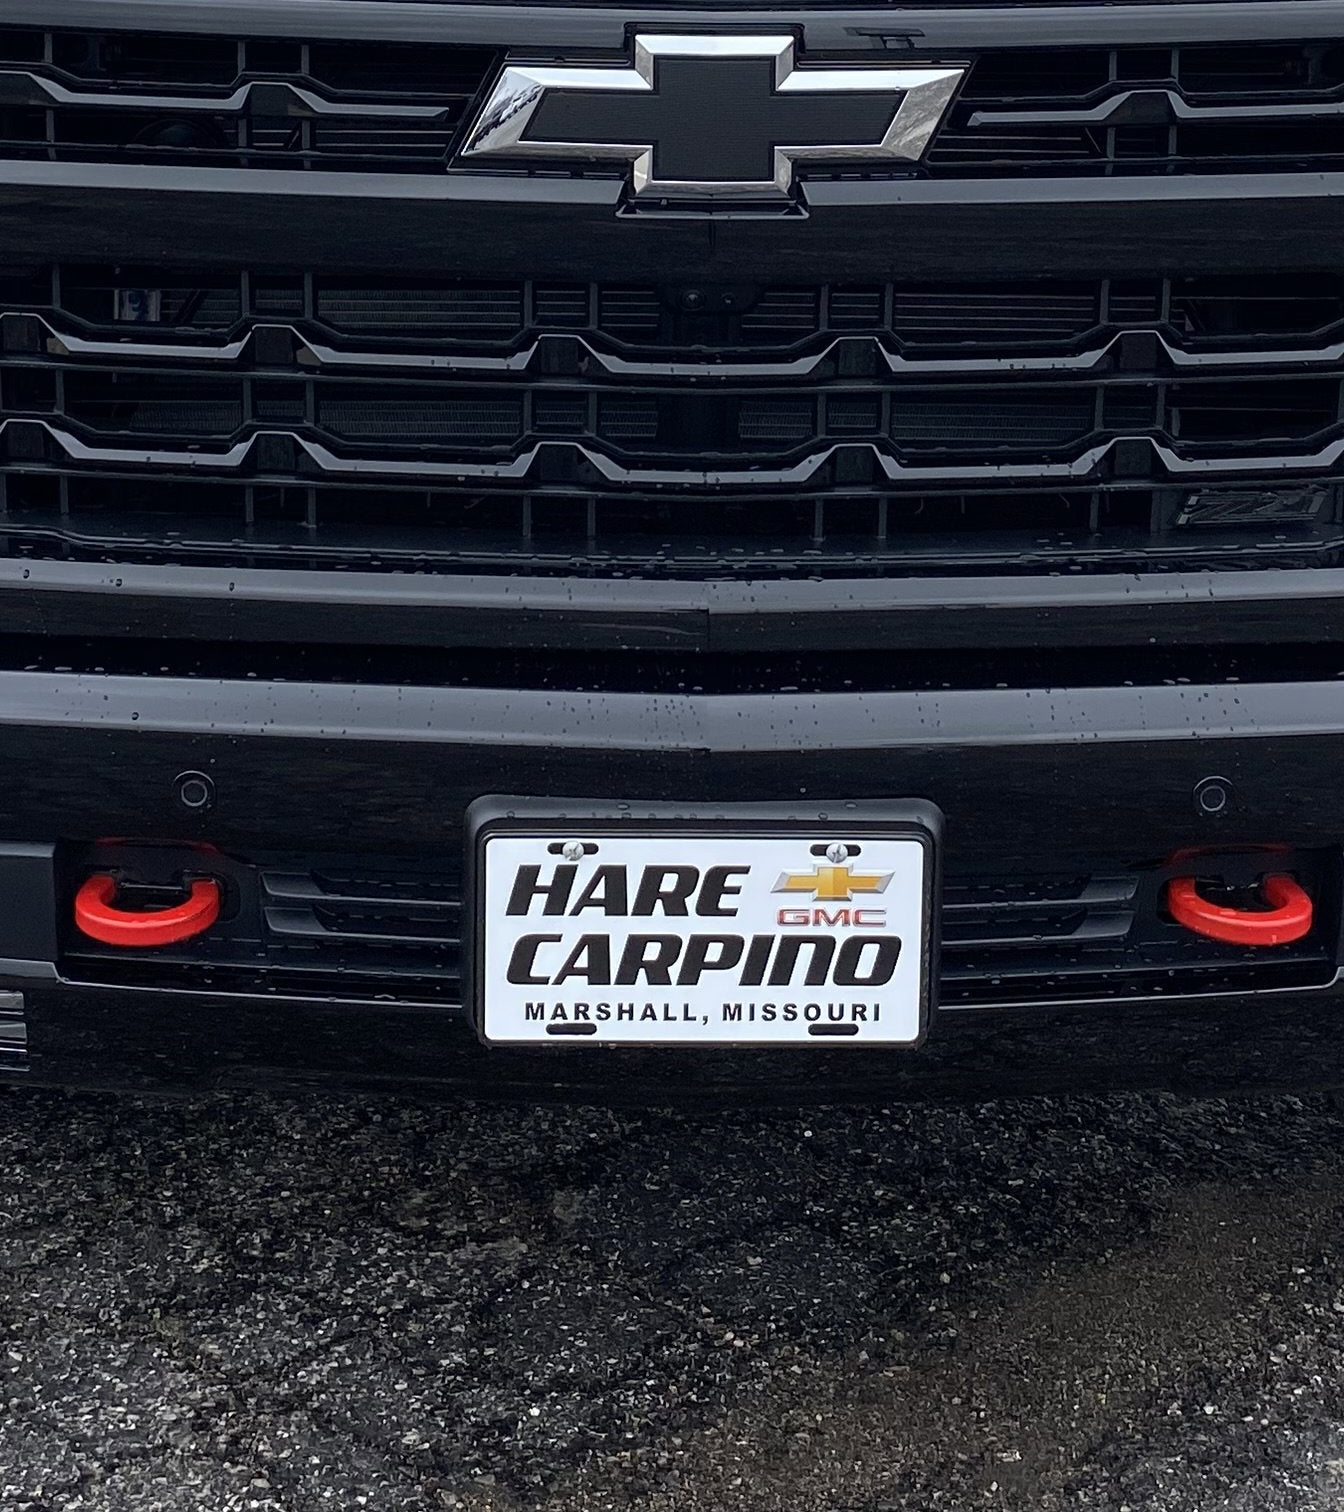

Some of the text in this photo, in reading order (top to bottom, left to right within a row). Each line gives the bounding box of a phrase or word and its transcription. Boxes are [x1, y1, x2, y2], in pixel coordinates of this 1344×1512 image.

[504, 865, 750, 916] HARE
[776, 907, 889, 928] GMC
[506, 933, 903, 987] CARPINO
[524, 1002, 882, 1025] MARSHALL, MISSOURI
